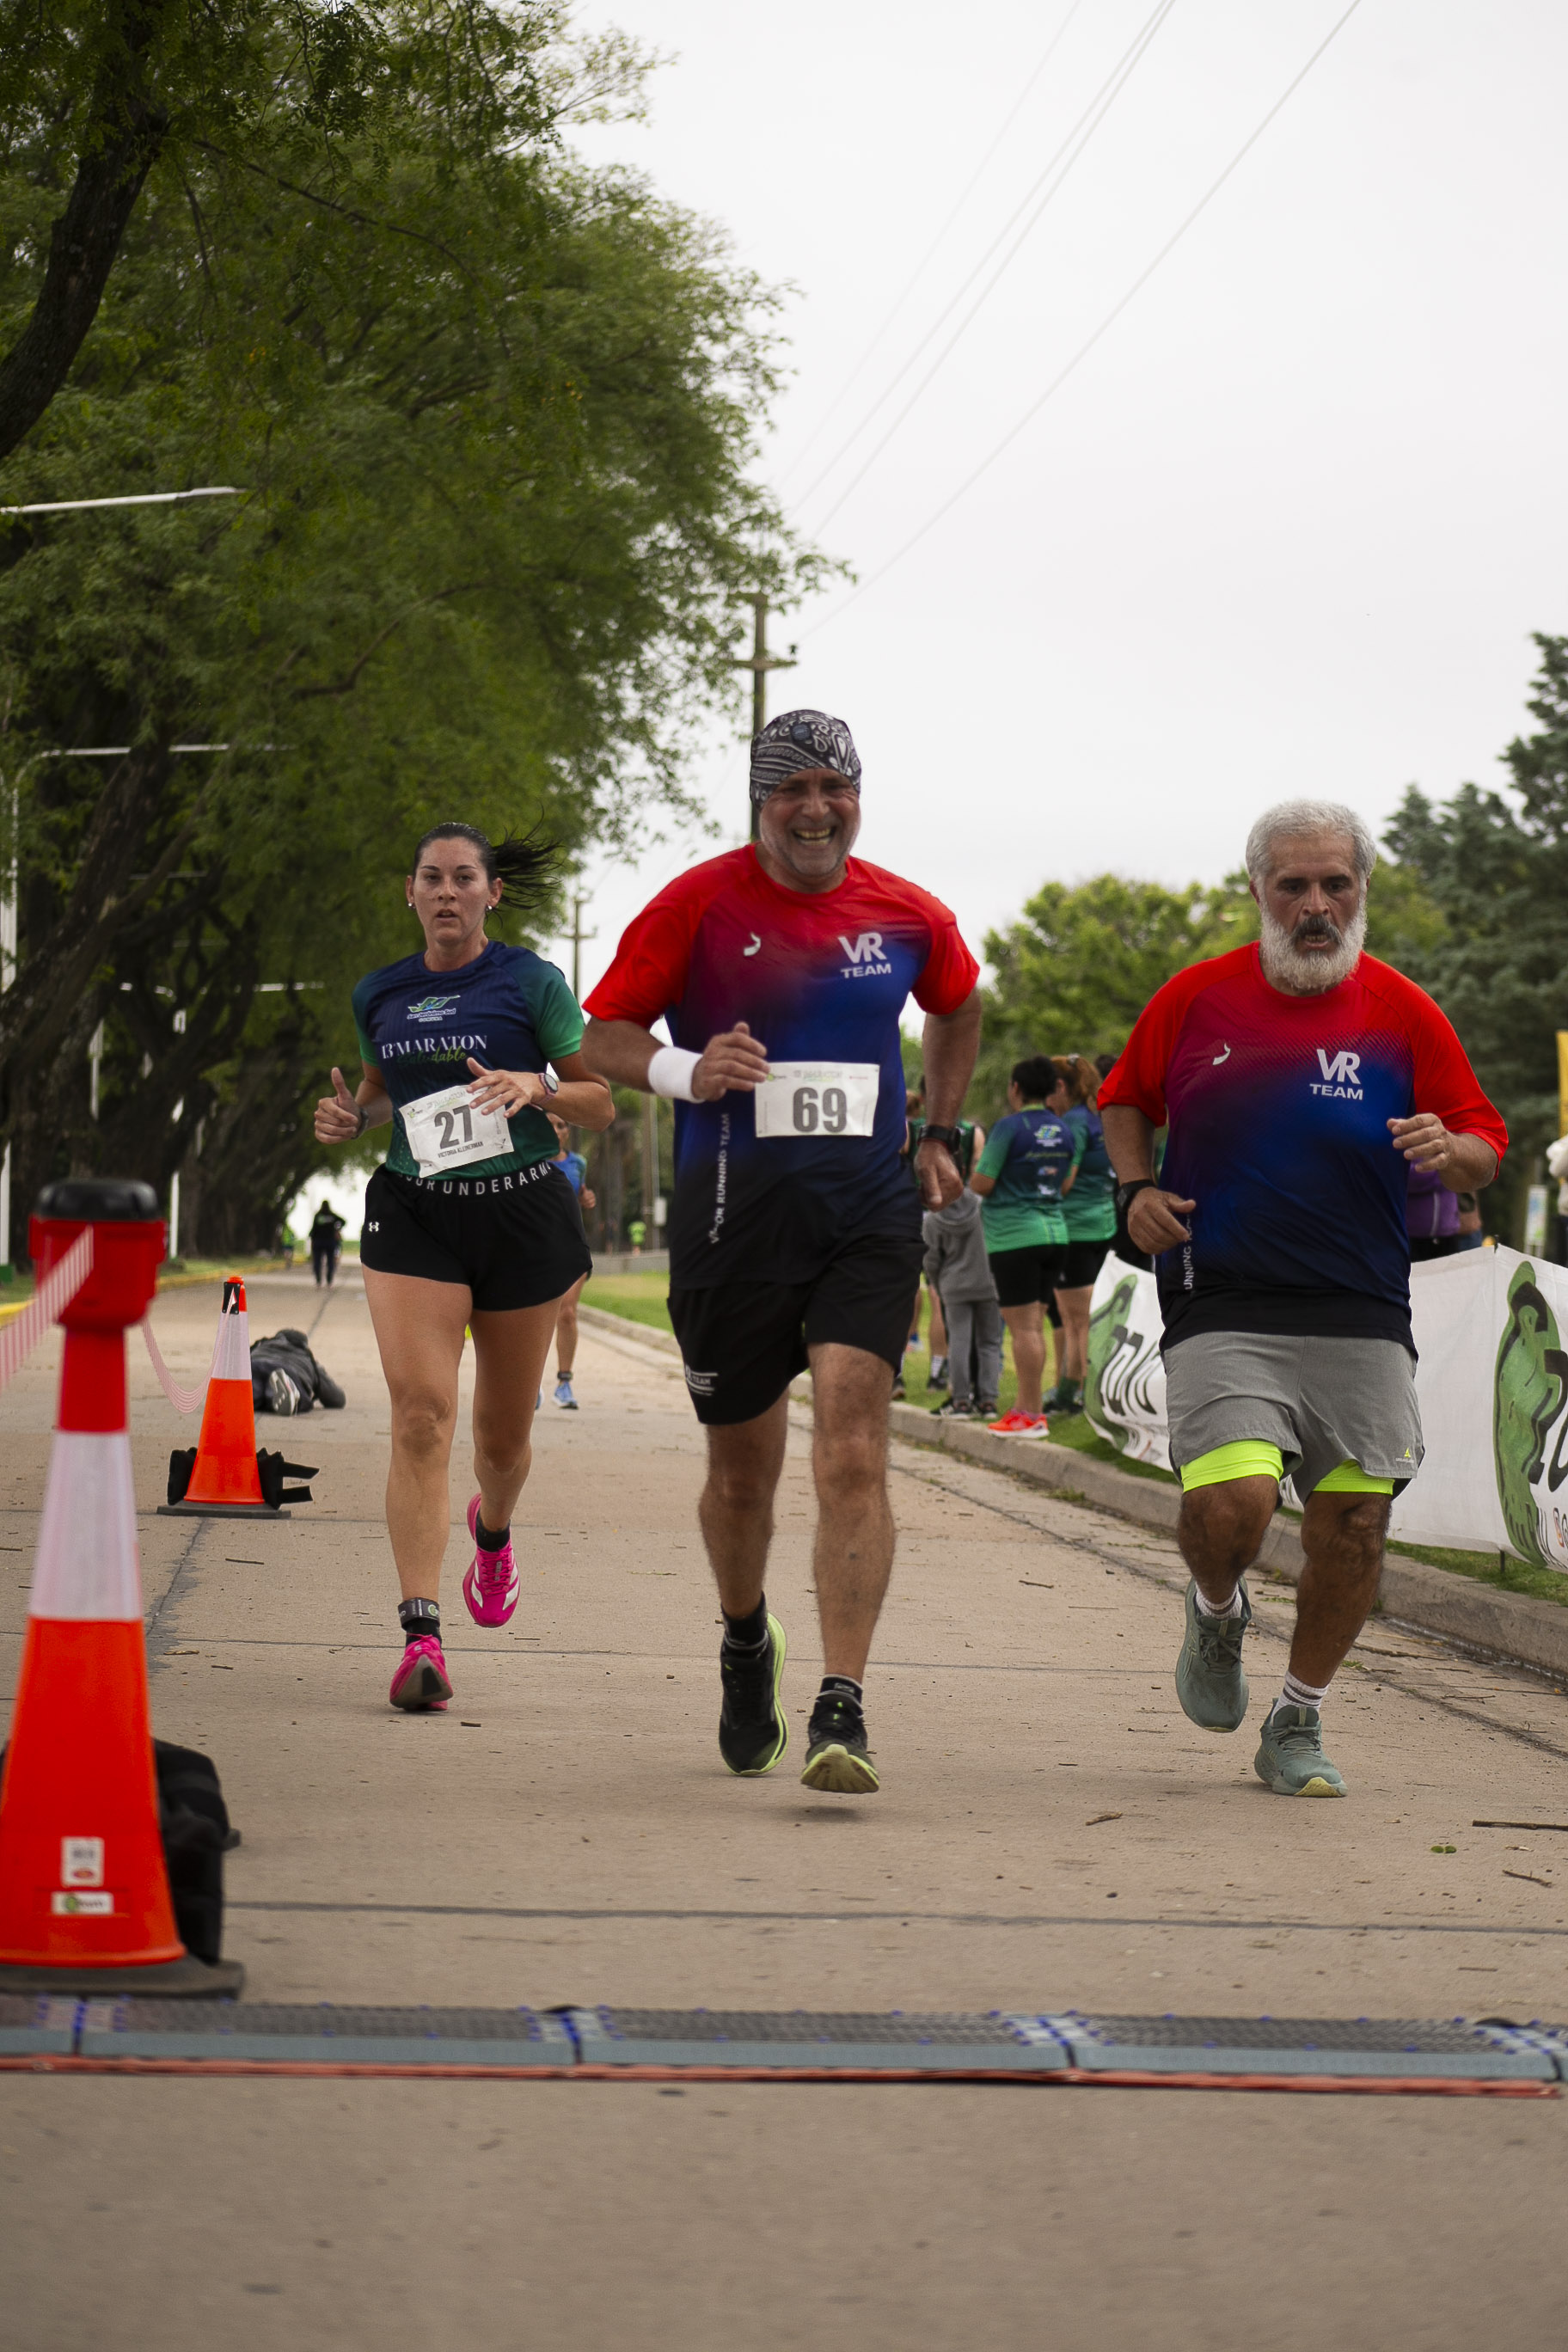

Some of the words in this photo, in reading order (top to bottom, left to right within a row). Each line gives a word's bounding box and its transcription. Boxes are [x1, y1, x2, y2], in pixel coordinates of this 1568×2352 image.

[837, 932, 887, 964] VR
[841, 964, 891, 979] TEAM
[396, 1035, 487, 1056] MARATON
[1316, 1049, 1361, 1085] VR
[1309, 1083, 1363, 1100] TEAM
[793, 1087, 848, 1133] 69
[433, 1104, 473, 1150] 27
[720, 1113, 730, 1147] TEAM
[438, 1150, 457, 1159] VICTORIA
[443, 1176, 514, 1196] UNDER
[716, 1149, 728, 1204] RUNNING
